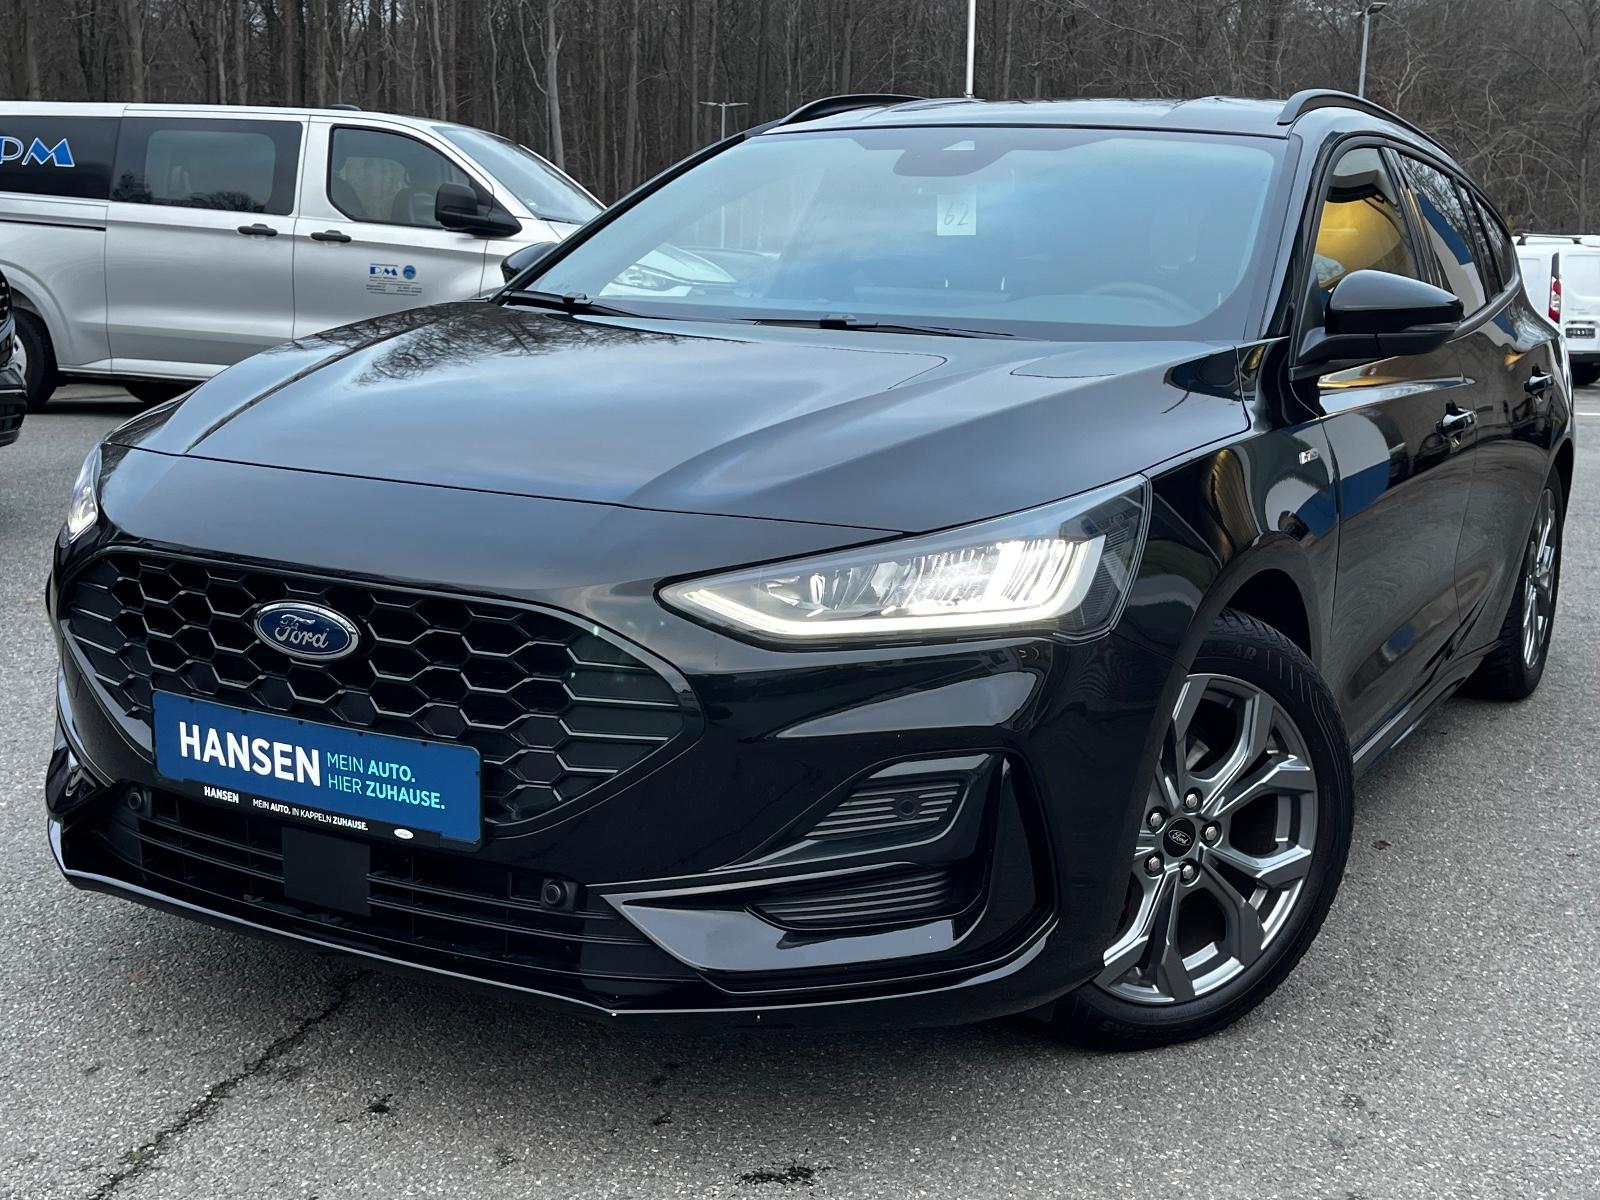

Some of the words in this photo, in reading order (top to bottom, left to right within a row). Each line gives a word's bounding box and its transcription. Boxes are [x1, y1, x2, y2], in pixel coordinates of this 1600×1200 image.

[944, 201, 969, 226] 62
[275, 614, 330, 649] Ford
[179, 721, 320, 787] HANSEN
[327, 751, 363, 773] MEIN
[367, 760, 416, 783] AUTO.
[204, 785, 239, 803] HANSEN
[252, 798, 269, 810] MEIN
[270, 802, 291, 815] AUTO.
[291, 807, 300, 817] IN
[300, 809, 332, 824] KAPPELN
[332, 816, 369, 831] ZUHAUSE.
[328, 773, 362, 795] HIER
[365, 780, 446, 810] ZUHAUSE.
